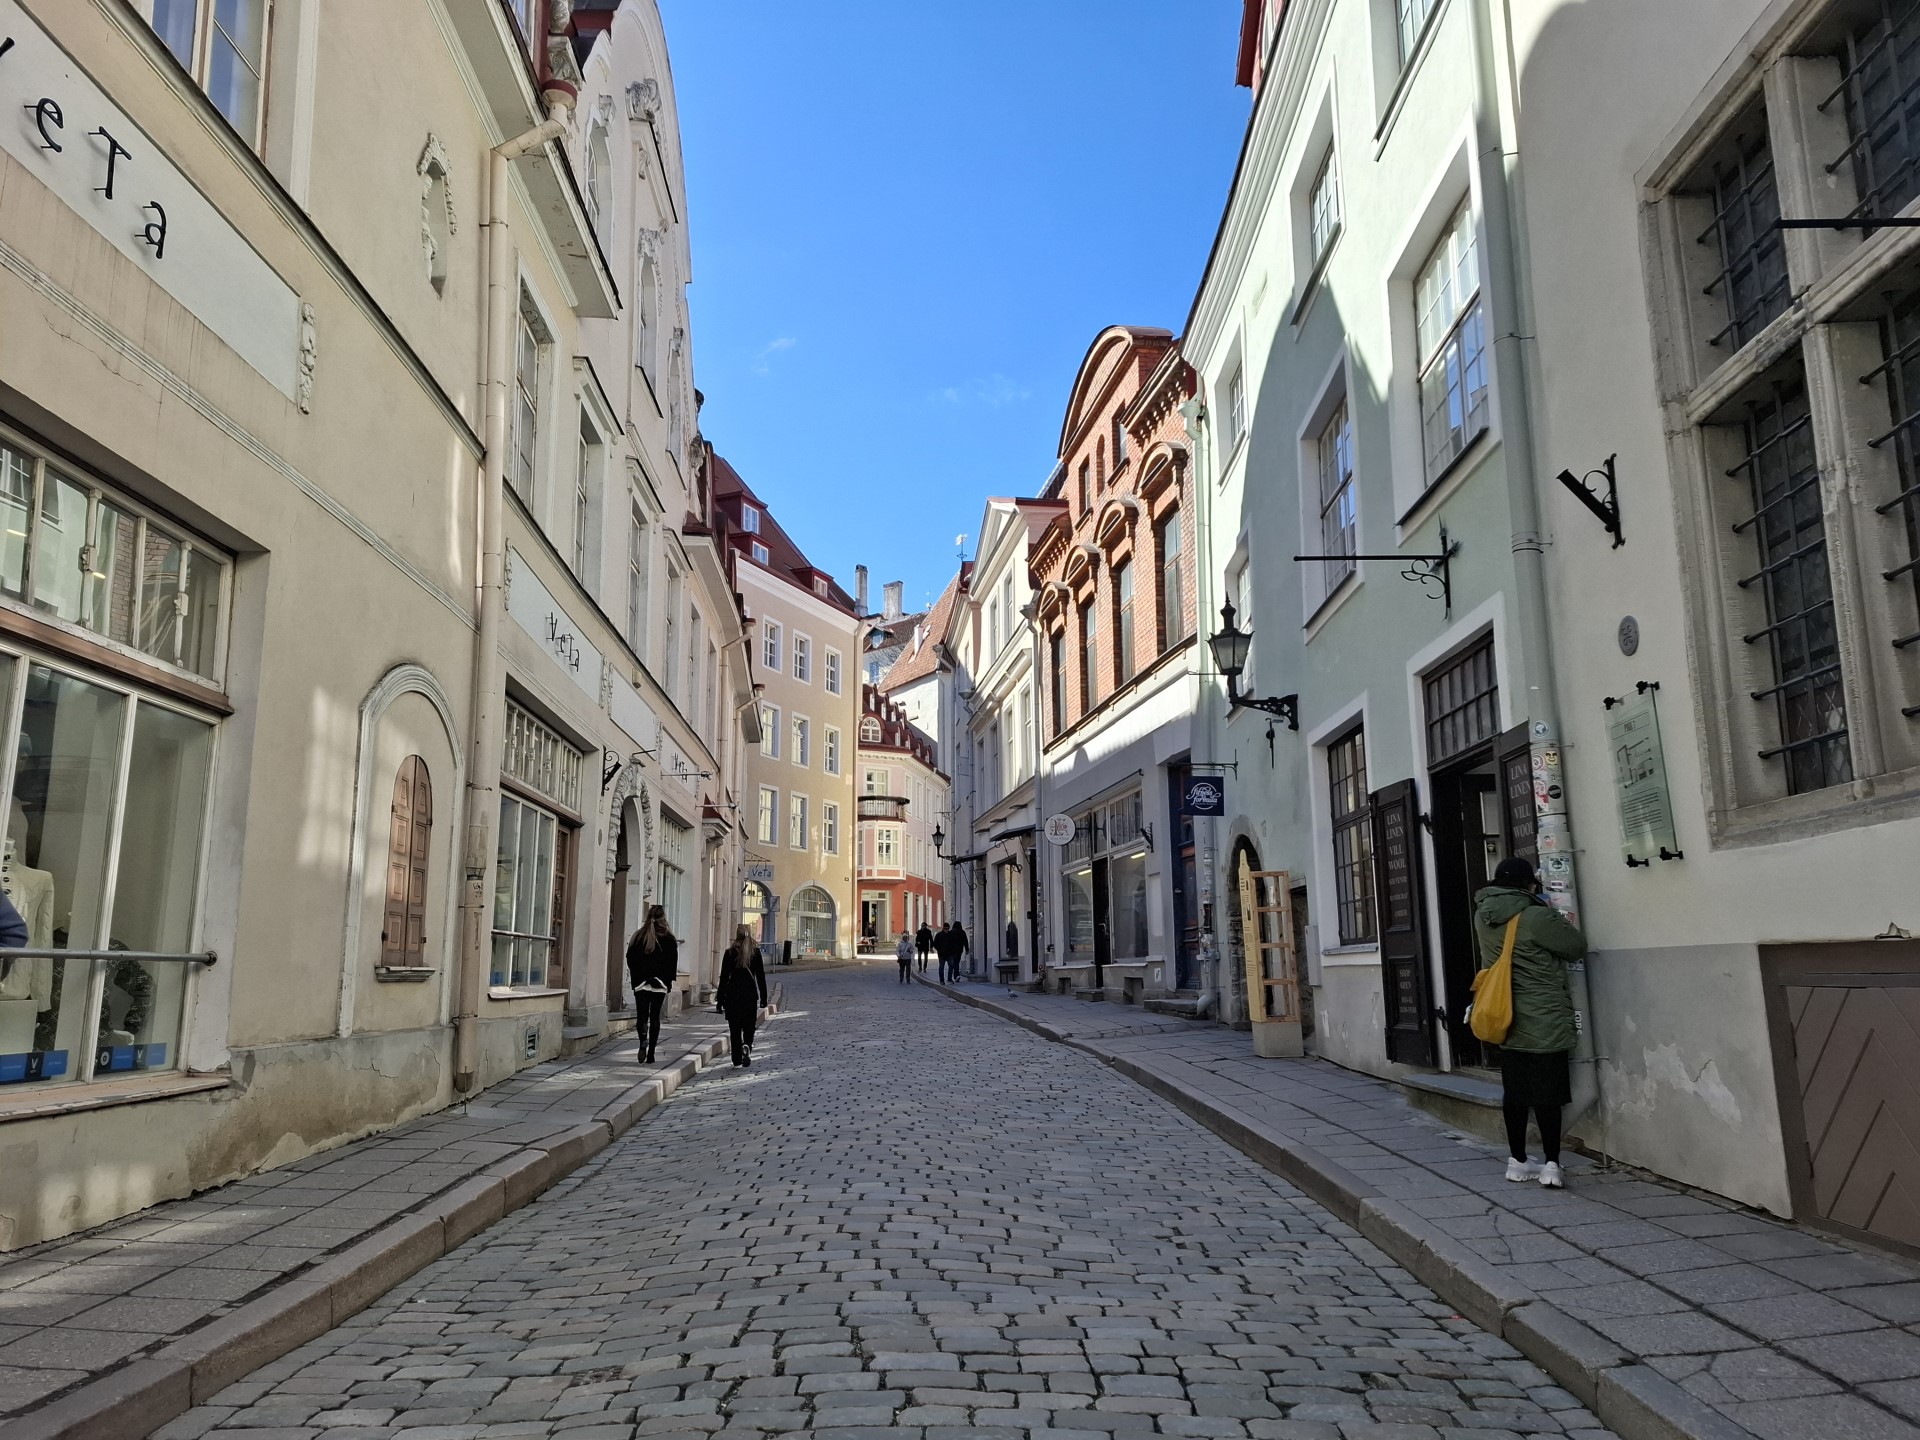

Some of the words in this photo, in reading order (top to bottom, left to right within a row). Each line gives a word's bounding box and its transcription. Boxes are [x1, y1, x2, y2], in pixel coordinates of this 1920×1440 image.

[0, 37, 166, 259] eTa
[1511, 763, 1528, 780] LINA
[1510, 780, 1531, 799] LINEN
[1386, 813, 1401, 826] LINA
[1514, 803, 1531, 820] VILL
[1386, 826, 1404, 840] LINEN
[1513, 821, 1535, 839] WOOL
[1389, 844, 1404, 856] VILL
[1388, 857, 1407, 870] WOOL
